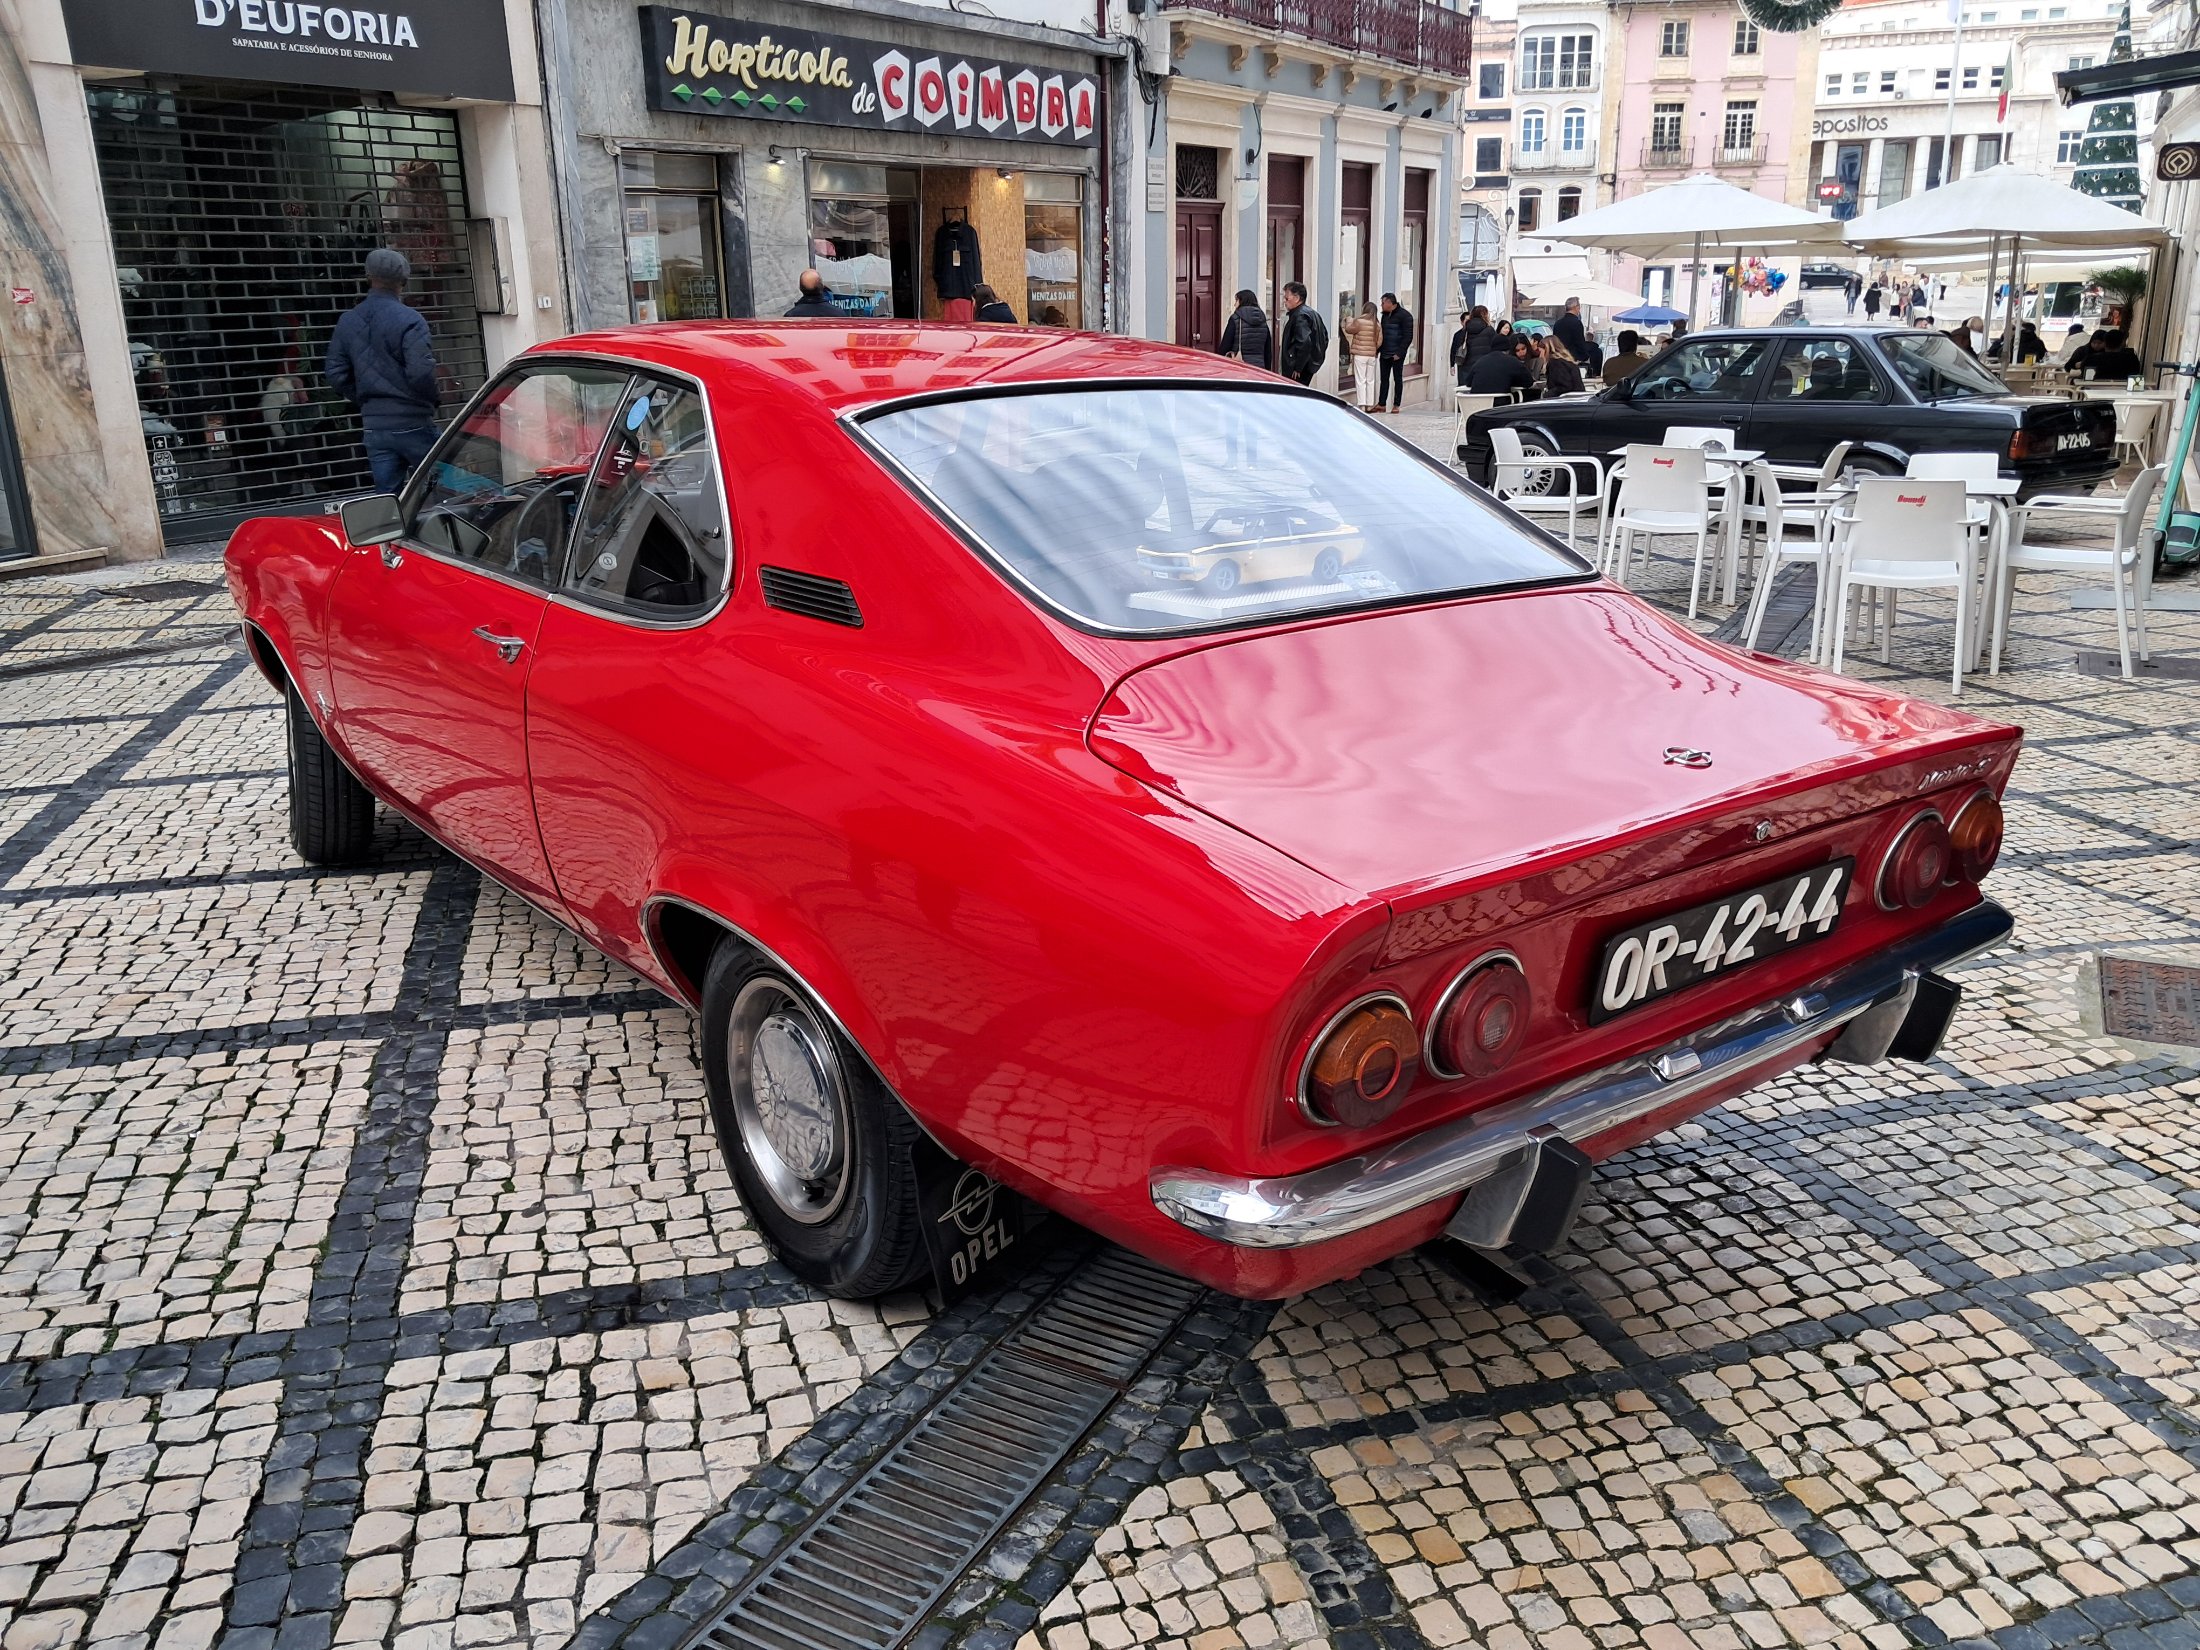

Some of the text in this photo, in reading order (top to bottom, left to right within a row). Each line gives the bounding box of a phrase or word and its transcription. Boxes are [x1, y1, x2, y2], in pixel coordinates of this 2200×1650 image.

[194, 0, 419, 48] D'EUFORIA
[231, 37, 393, 62] SAPATARIA E ACESSÓRIOS DE SENHORA
[851, 82, 876, 114] de
[1602, 867, 1844, 1011] OR-42-44
[950, 1217, 1014, 1286] OPEL
